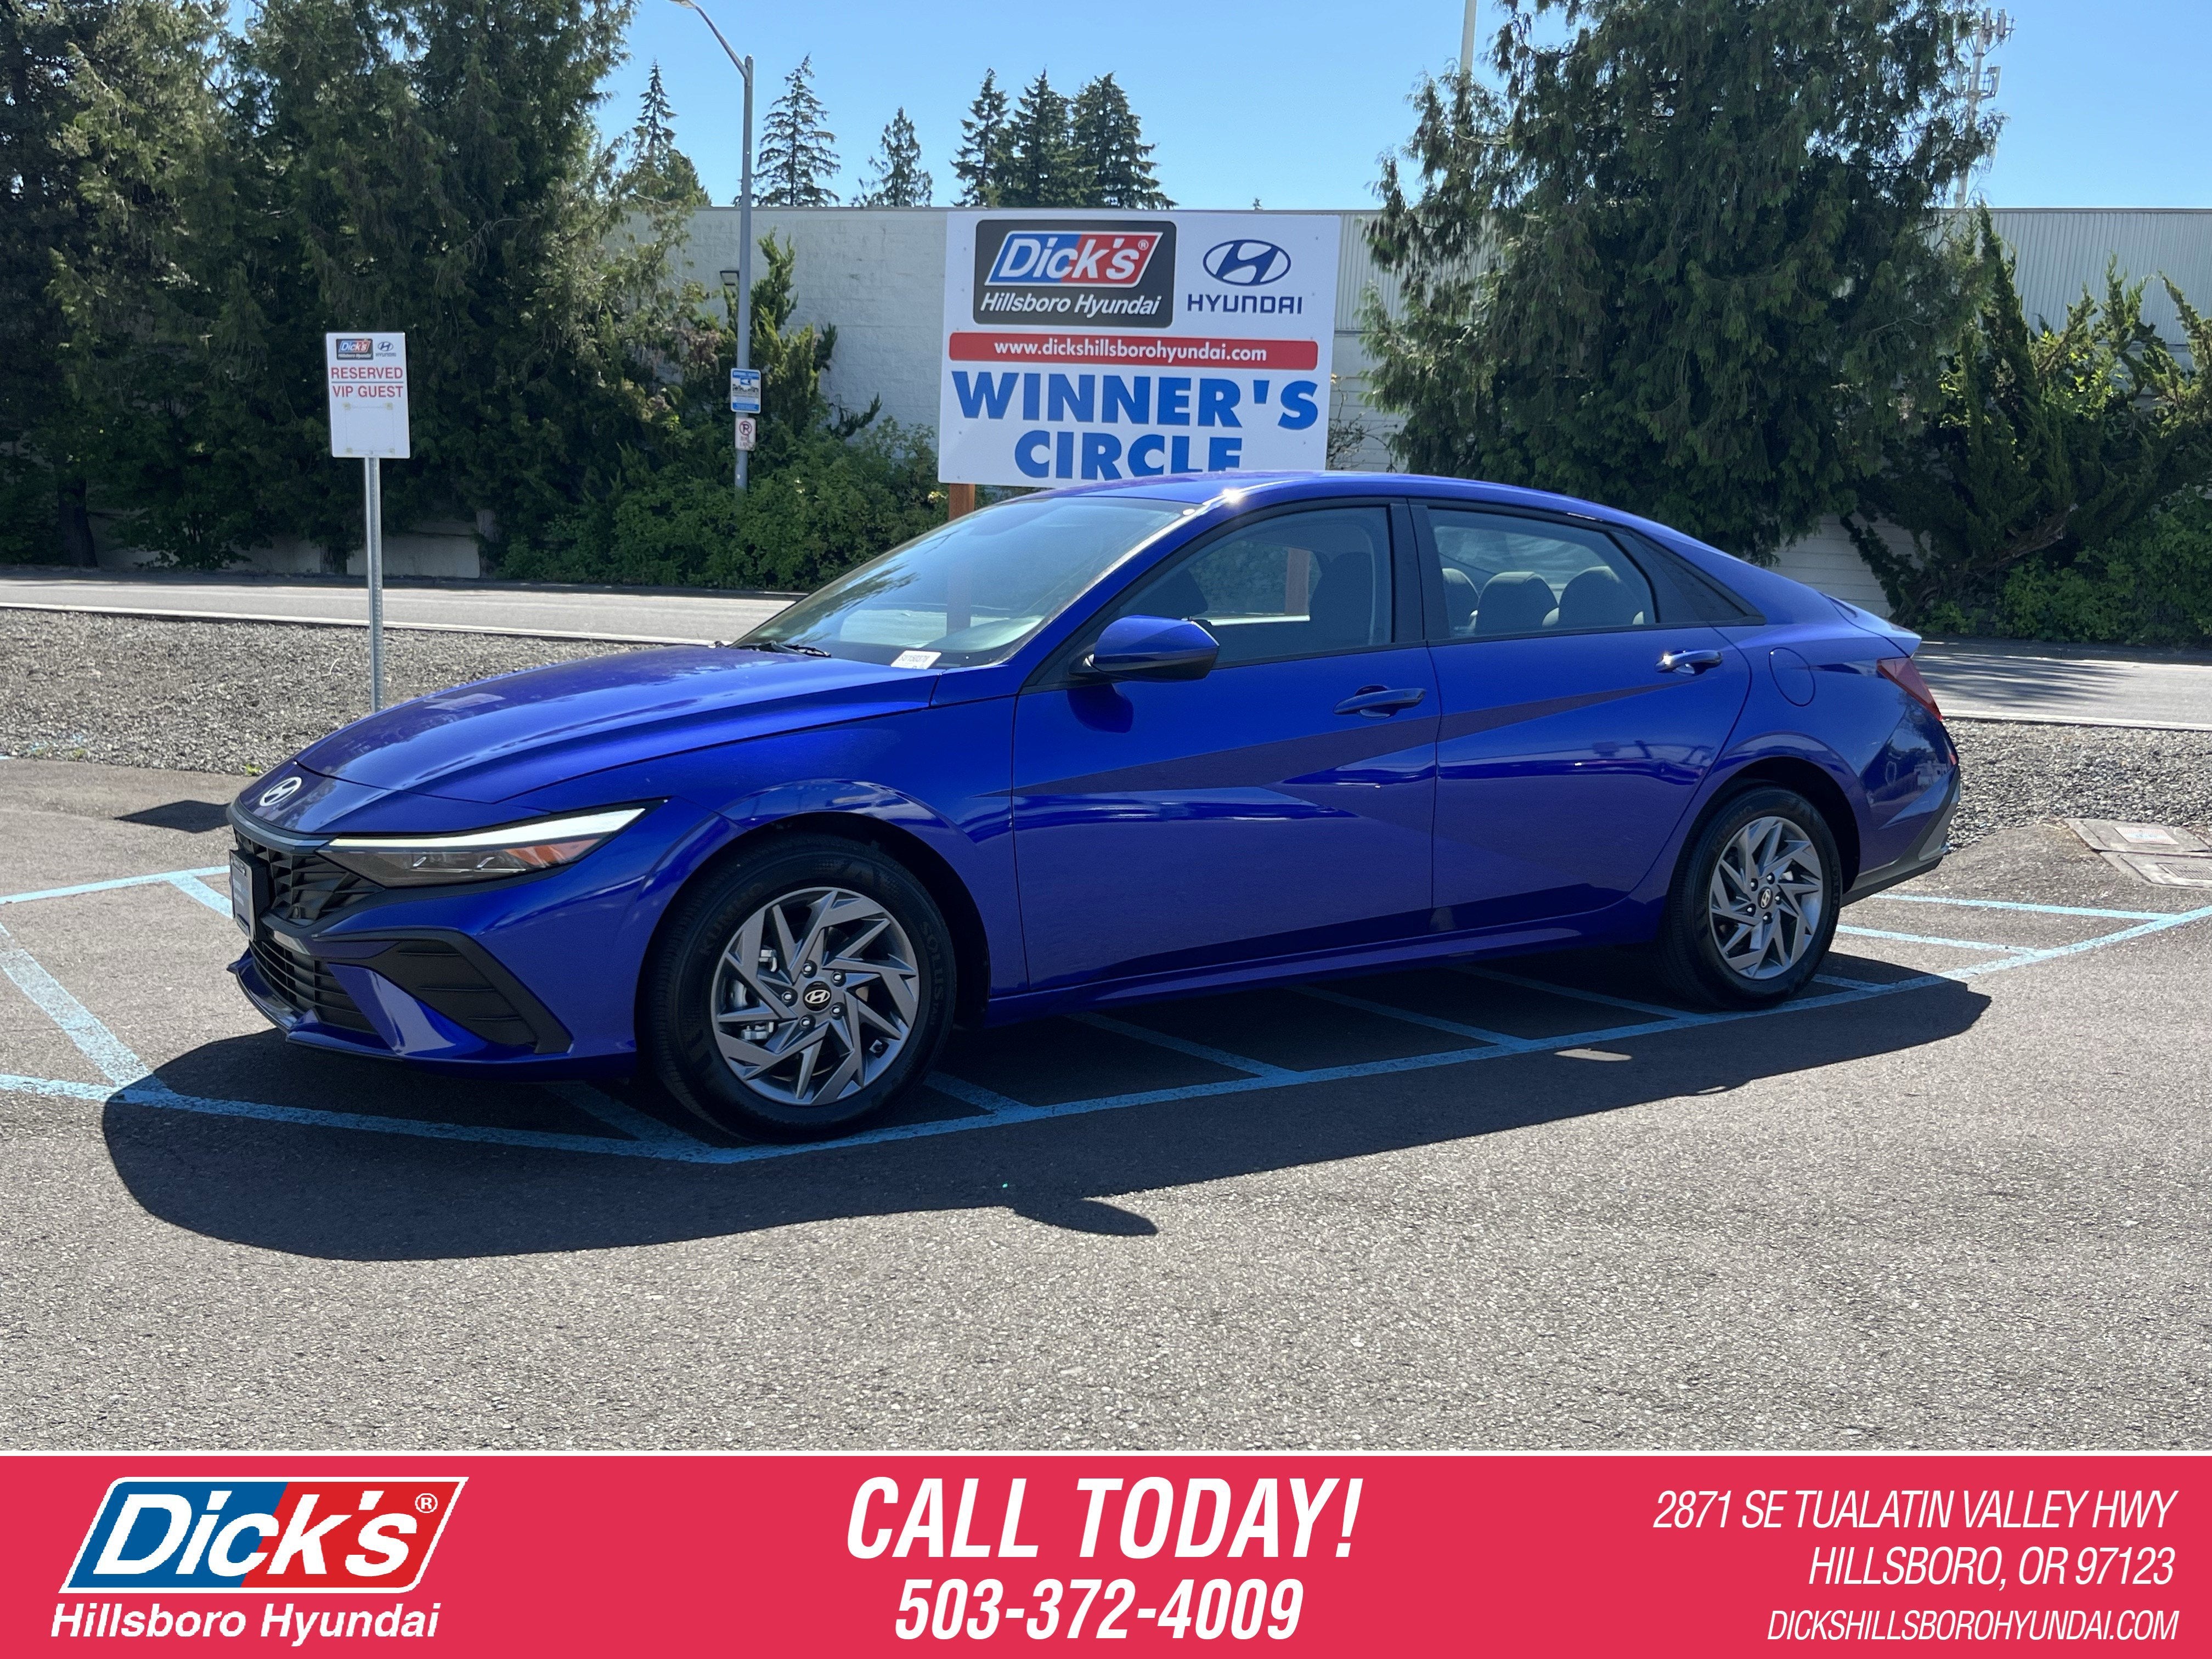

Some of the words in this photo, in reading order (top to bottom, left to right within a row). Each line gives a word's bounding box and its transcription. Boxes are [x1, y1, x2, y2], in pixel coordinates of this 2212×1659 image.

[980, 293, 1071, 313] Hillsboro
[1074, 294, 1161, 318] Hyundai
[1188, 294, 1302, 315] HYUNDAI
[994, 338, 1267, 363] www.dickshillsborohyundai.com
[331, 367, 403, 379] RESERVED
[332, 386, 354, 398] VIP
[358, 386, 404, 398] GUEST
[952, 371, 1318, 430] WINNER'S
[1014, 430, 1243, 481] CIRCLE
